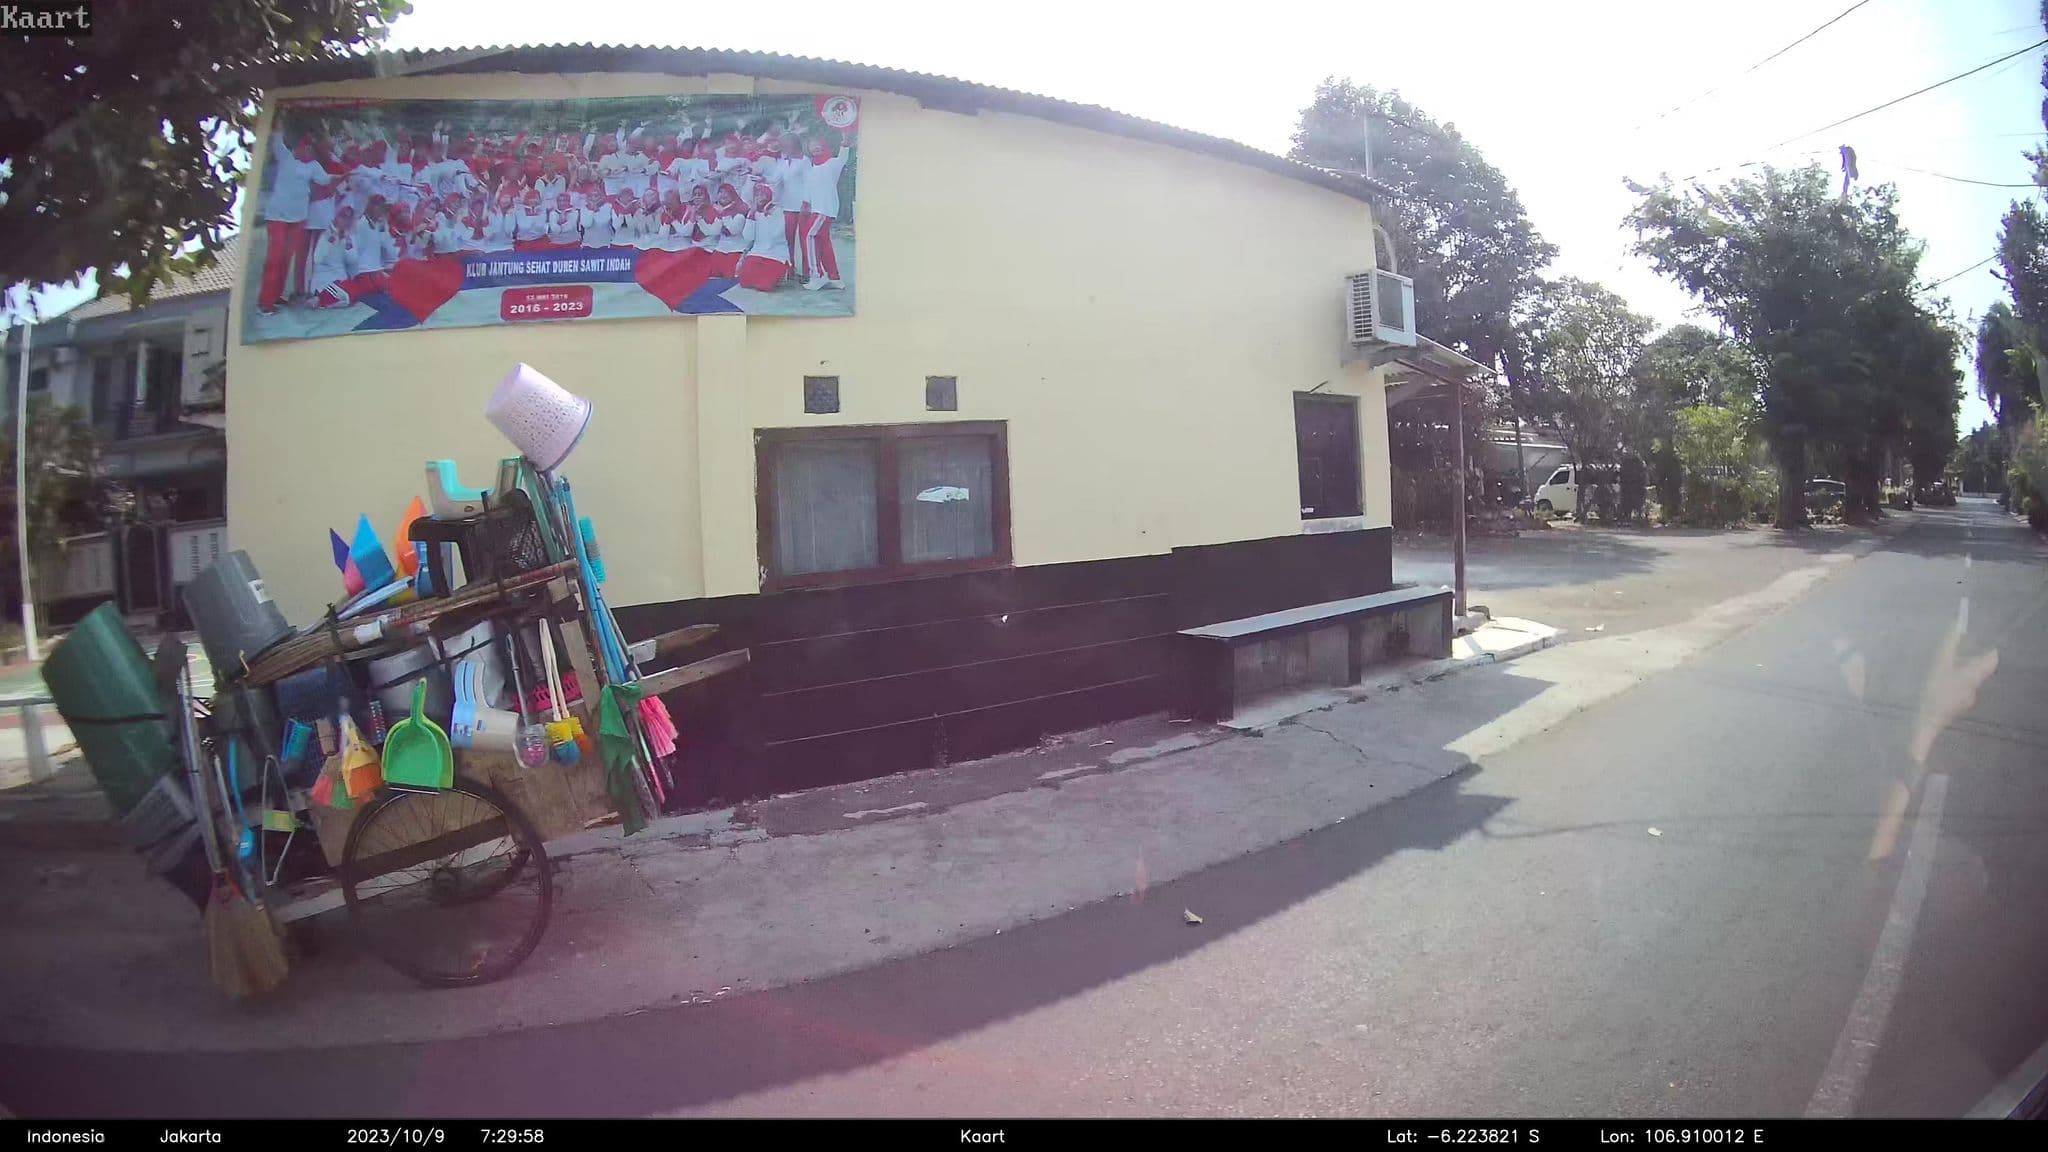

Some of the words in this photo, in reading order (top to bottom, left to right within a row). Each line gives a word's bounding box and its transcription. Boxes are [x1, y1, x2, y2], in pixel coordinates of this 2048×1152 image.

[466, 262, 487, 278] KLUB
[488, 260, 524, 277] JANTUNG
[526, 259, 550, 274] SEHAT
[552, 259, 579, 274] DUREN
[580, 258, 606, 273] SAWIT
[606, 258, 632, 272] INDAH
[510, 303, 541, 314] 2016
[552, 301, 584, 312] 2023
